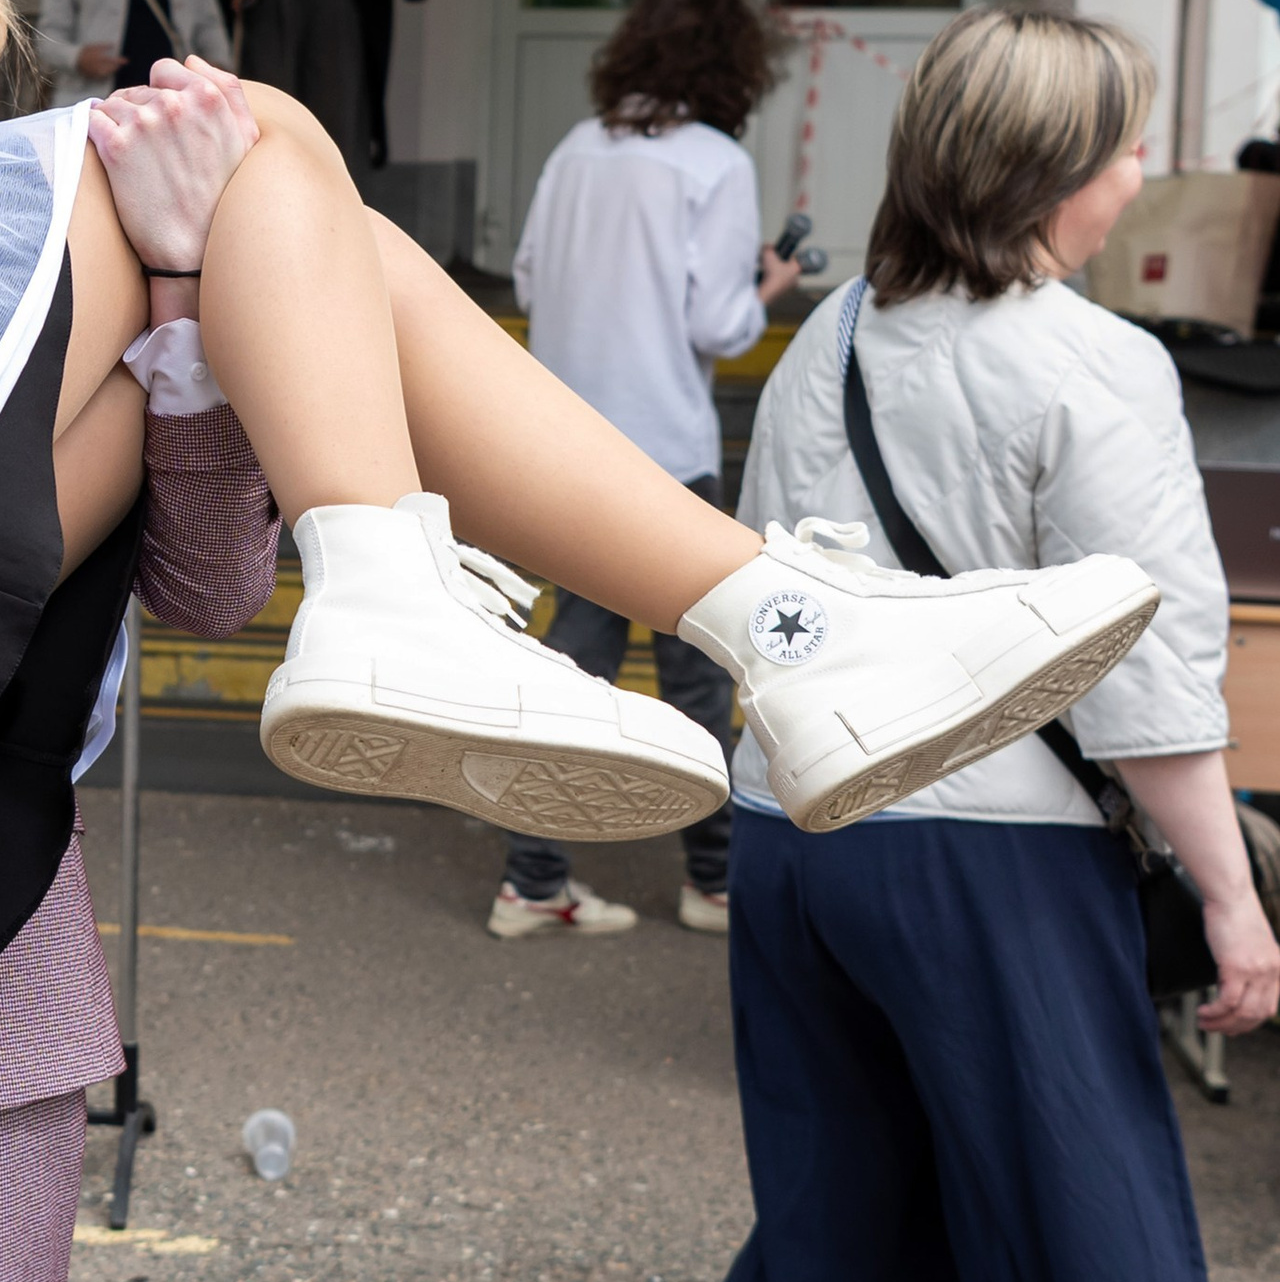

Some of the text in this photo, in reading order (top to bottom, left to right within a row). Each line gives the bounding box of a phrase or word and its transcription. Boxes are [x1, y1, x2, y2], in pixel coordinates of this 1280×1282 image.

[755, 594, 807, 633] CONVERSE
[779, 626, 824, 659] ALL STAR
